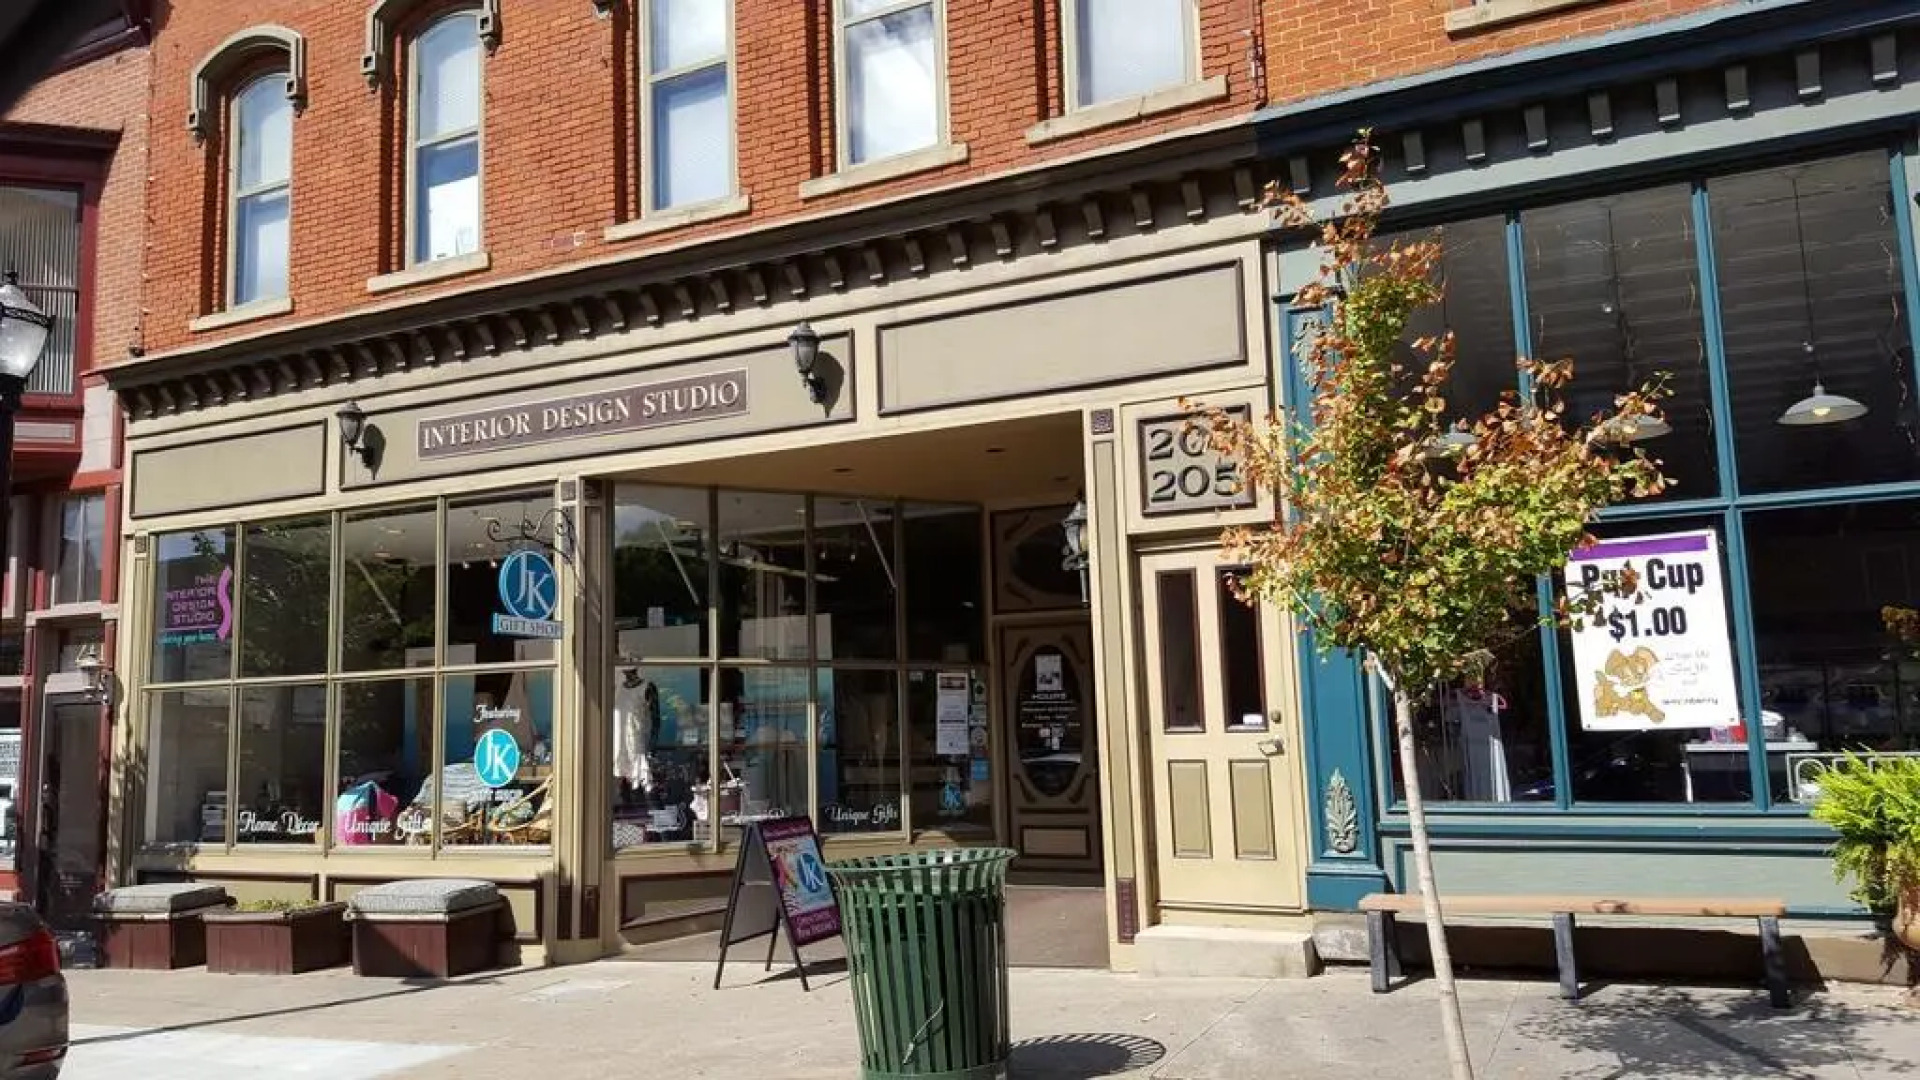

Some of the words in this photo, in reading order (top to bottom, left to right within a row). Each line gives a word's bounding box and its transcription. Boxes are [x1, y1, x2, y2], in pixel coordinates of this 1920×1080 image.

[422, 411, 531, 449] INTERIOR
[542, 397, 630, 431] DESIGN
[642, 379, 740, 417] STUDIO
[1149, 462, 1242, 502] 205
[1646, 558, 1704, 594] Cup
[1609, 606, 1687, 643] $1.00
[239, 811, 279, 833] Home
[344, 811, 391, 841] Unique
[826, 804, 869, 826] Unique
